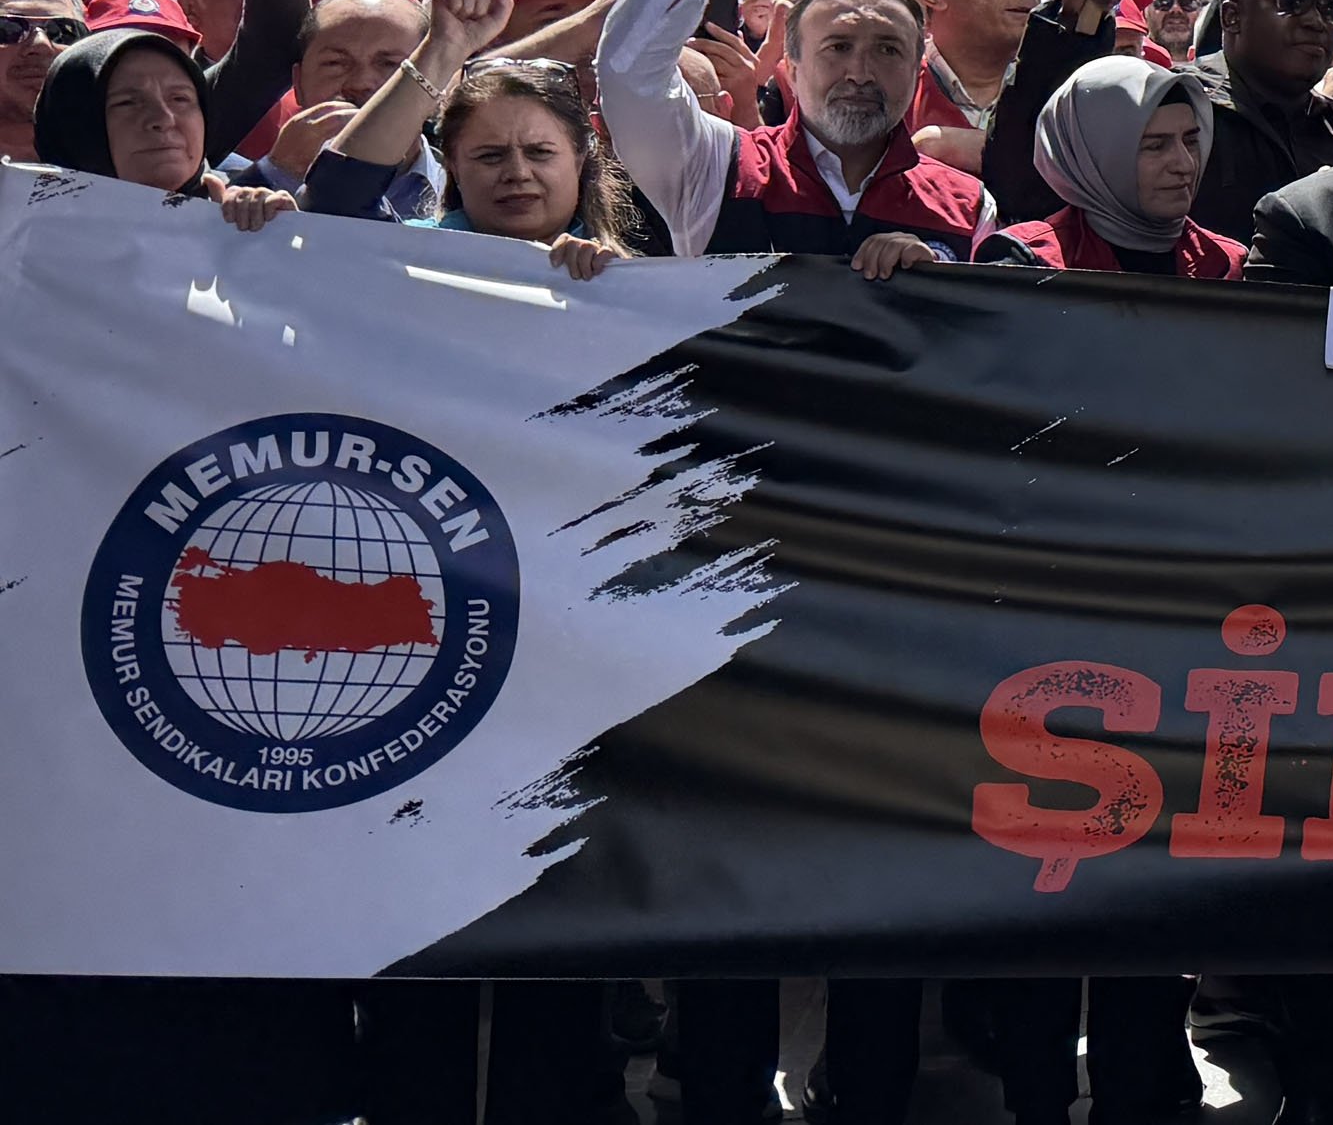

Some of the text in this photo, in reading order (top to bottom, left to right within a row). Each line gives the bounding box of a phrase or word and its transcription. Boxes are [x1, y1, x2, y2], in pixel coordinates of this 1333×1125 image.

[143, 431, 490, 553] MEMUR-SEN
[110, 573, 490, 791] MEMUR SENDİKALARI KONFEDERASYONU
[257, 745, 314, 766] 1995
